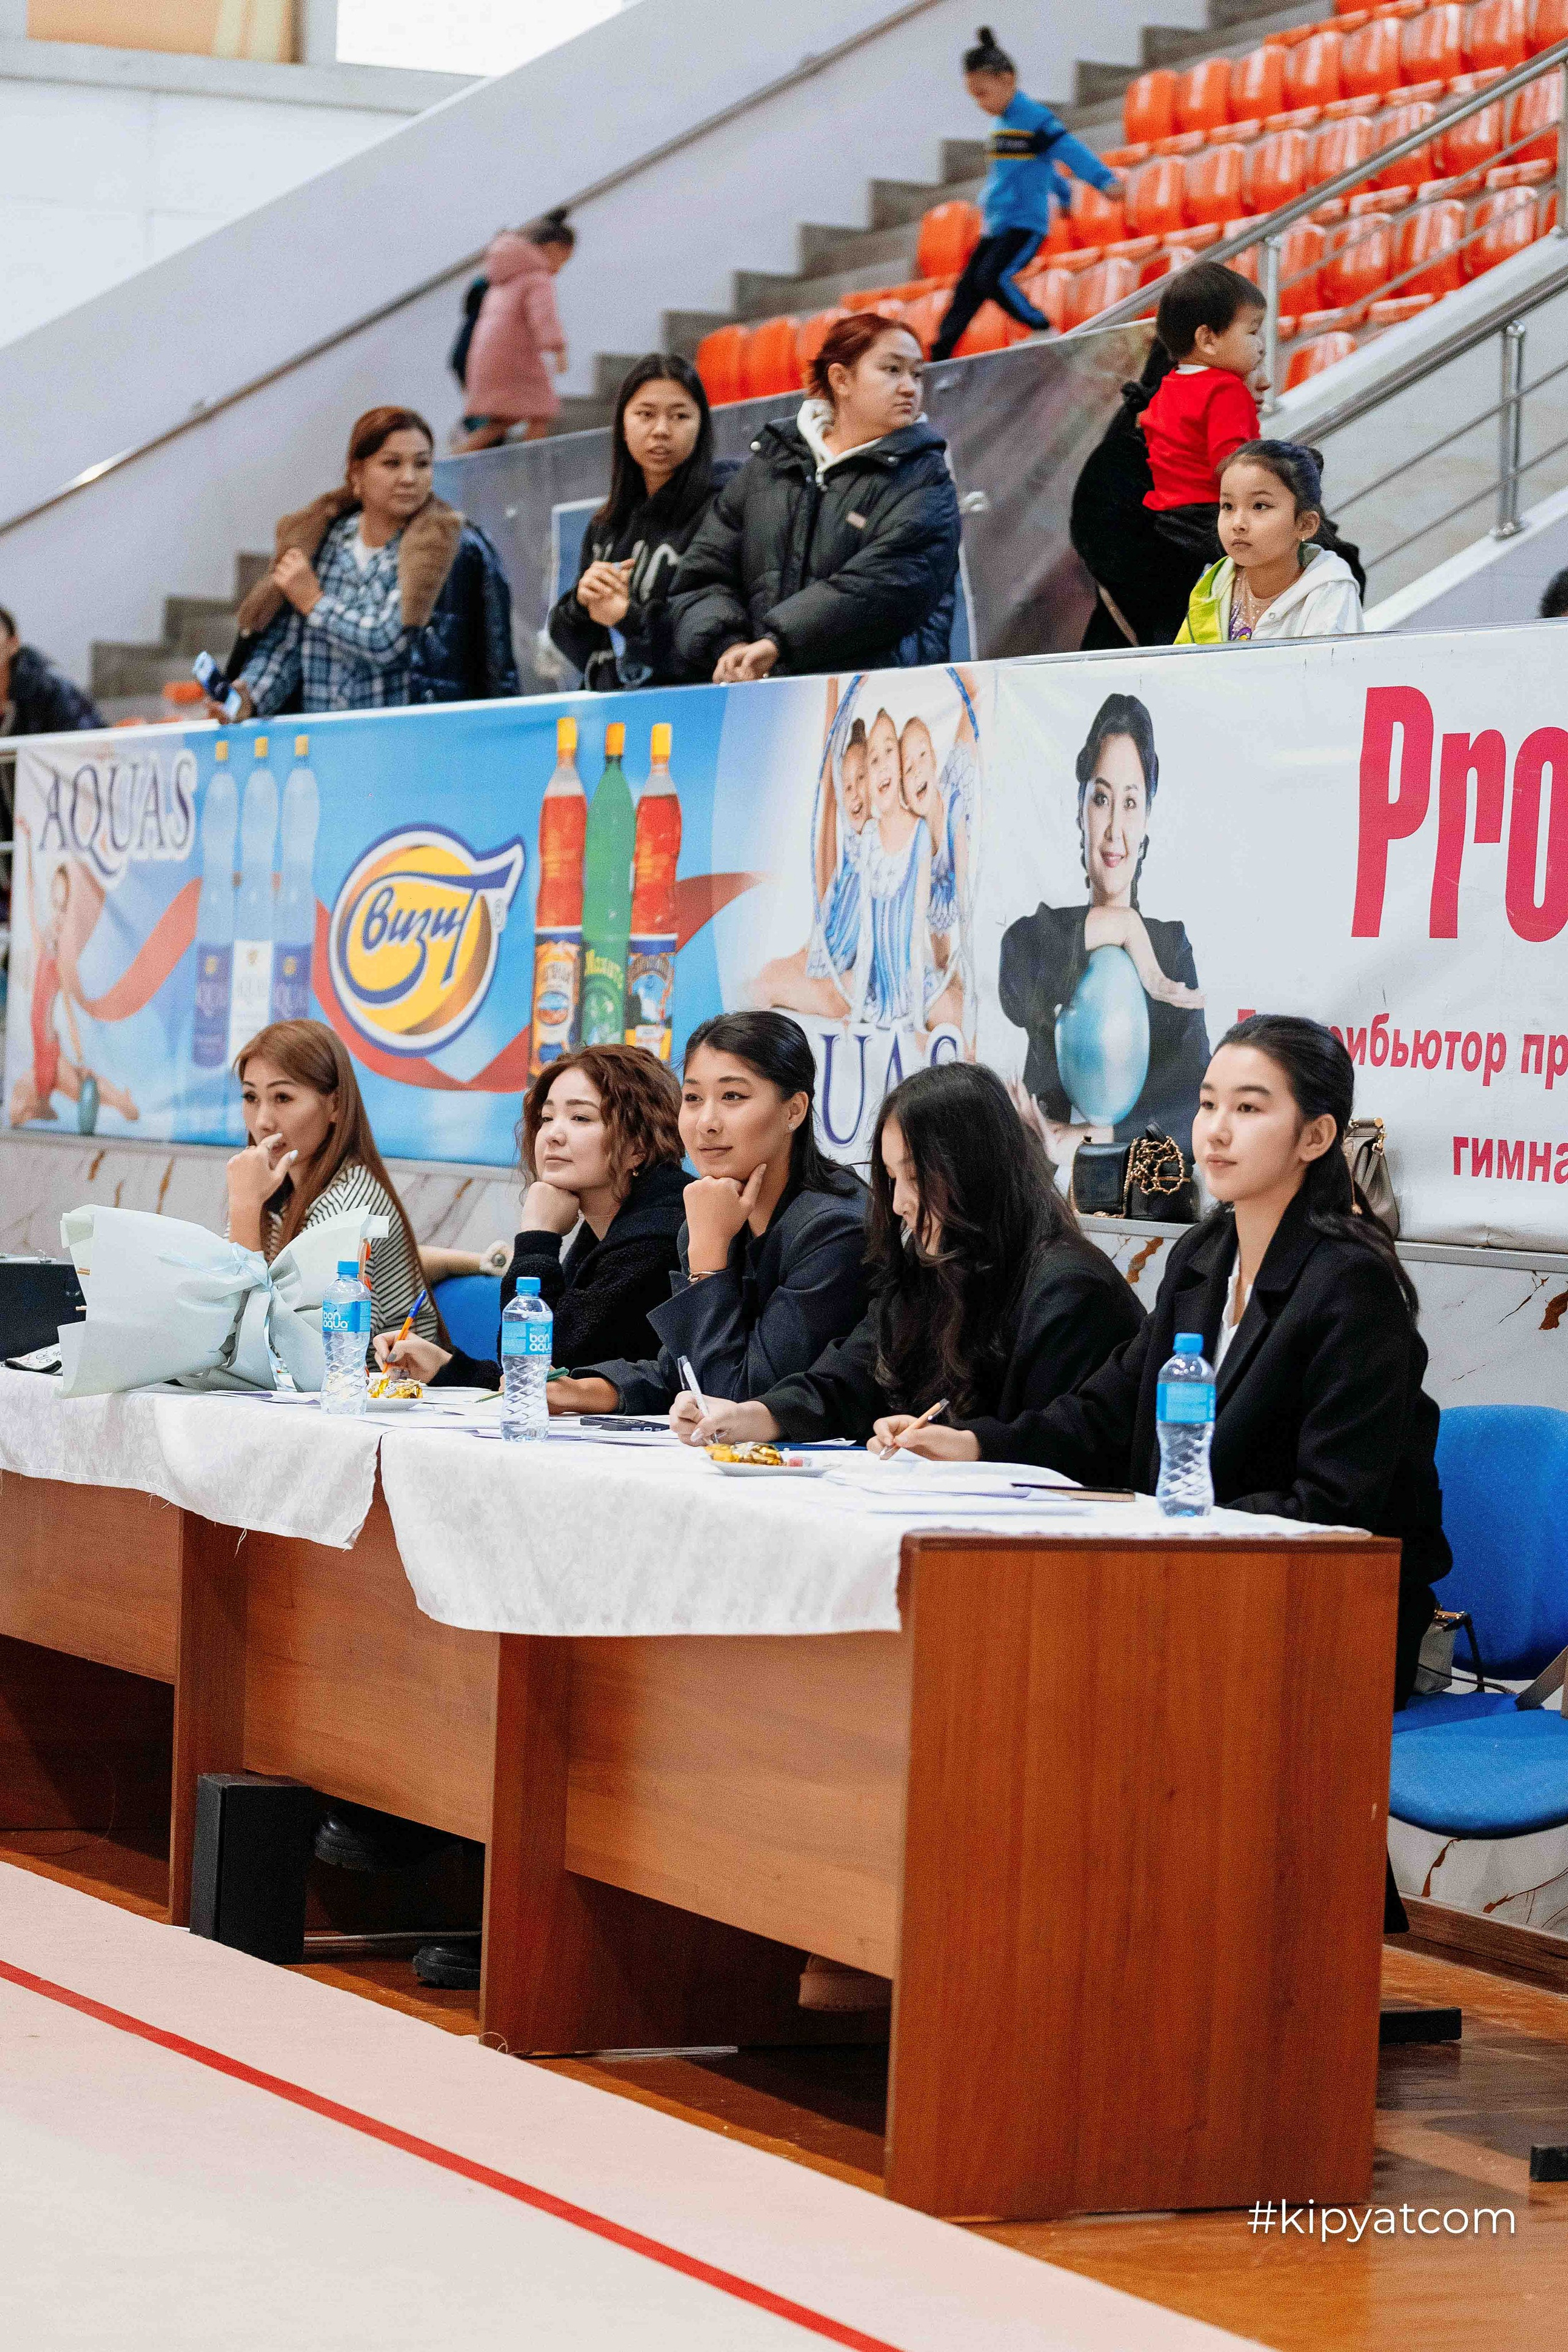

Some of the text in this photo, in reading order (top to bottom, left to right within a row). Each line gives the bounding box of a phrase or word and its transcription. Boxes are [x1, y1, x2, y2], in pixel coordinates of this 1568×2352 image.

[39, 758, 191, 877] AQUAS
[1237, 1009, 1507, 1087] ибьютор
[323, 1310, 341, 1320] bon
[323, 1319, 348, 1330] aqua
[529, 1333, 550, 1343] bon
